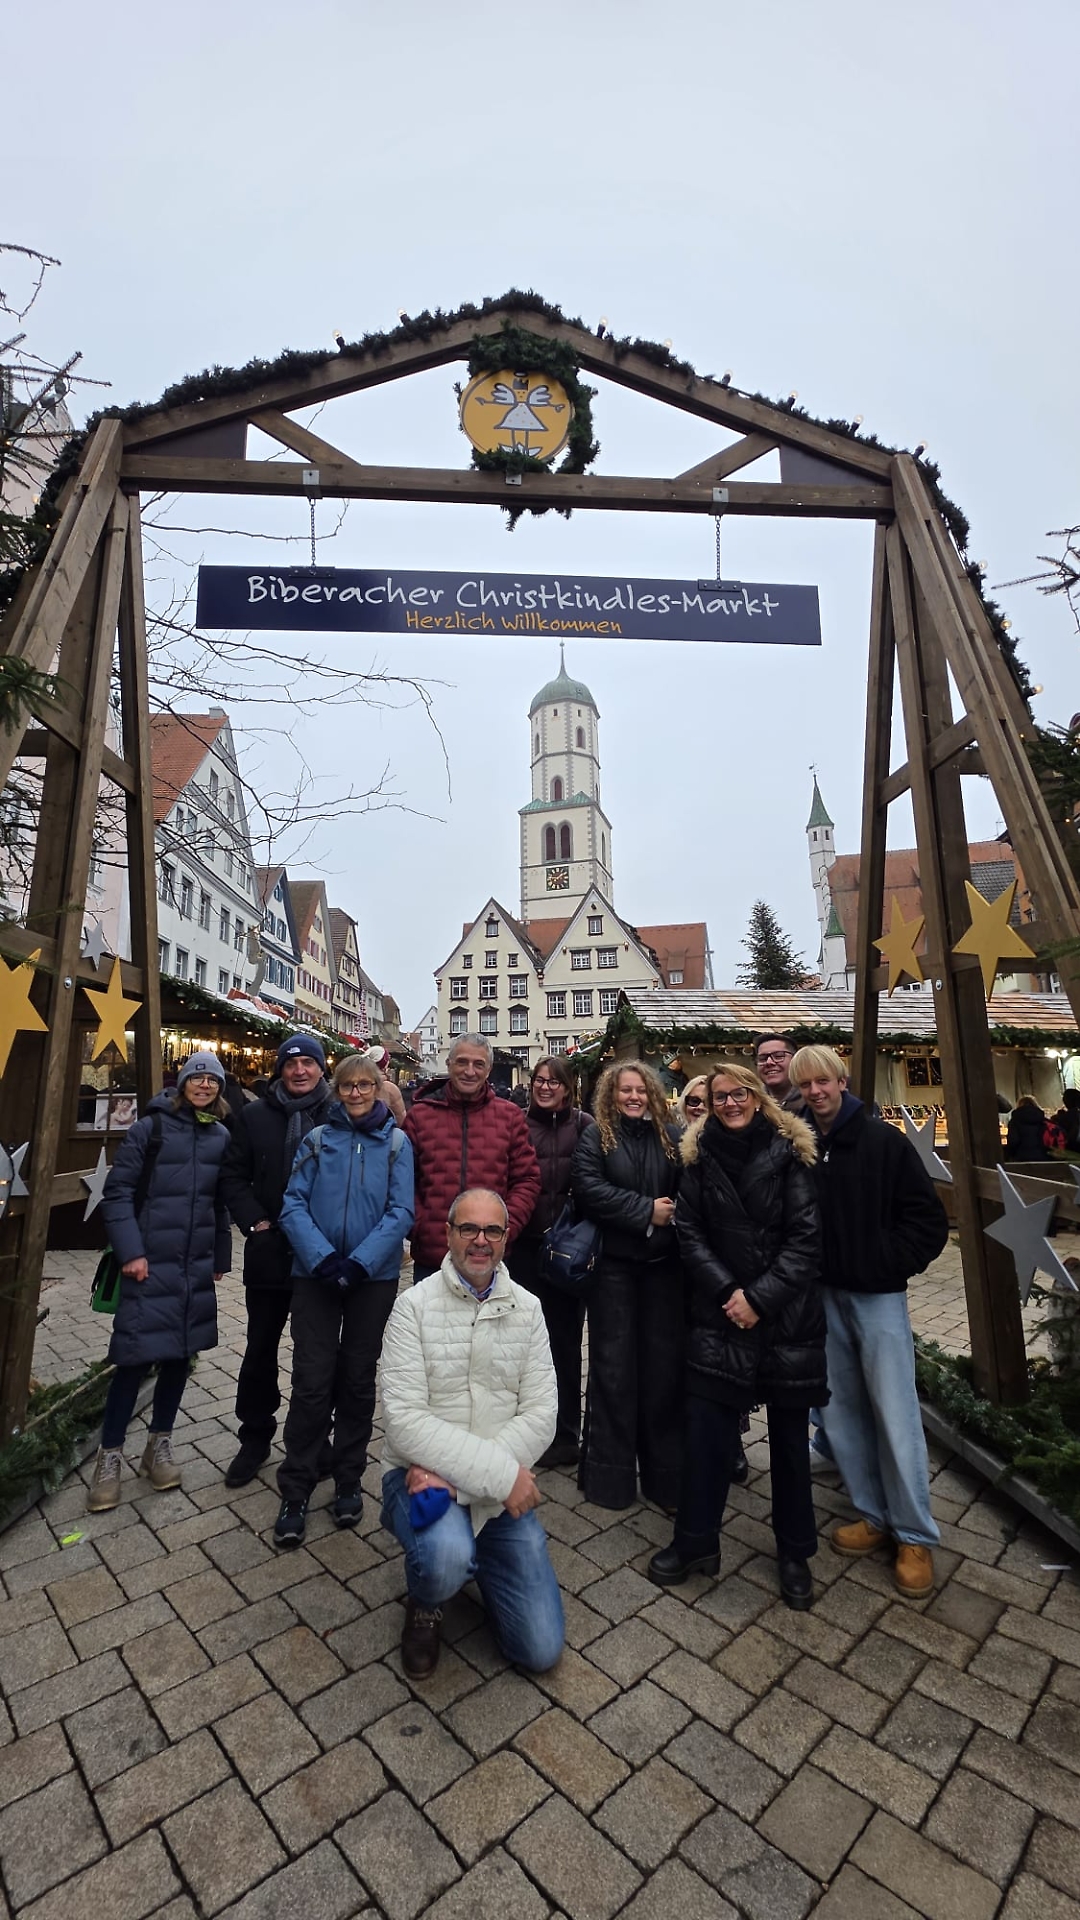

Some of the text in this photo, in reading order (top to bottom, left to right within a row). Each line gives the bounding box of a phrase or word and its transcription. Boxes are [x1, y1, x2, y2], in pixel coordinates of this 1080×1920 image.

[247, 575, 779, 616] Biberacher Christkindles-Markt
[406, 611, 622, 634] Herzlich Willkommen
